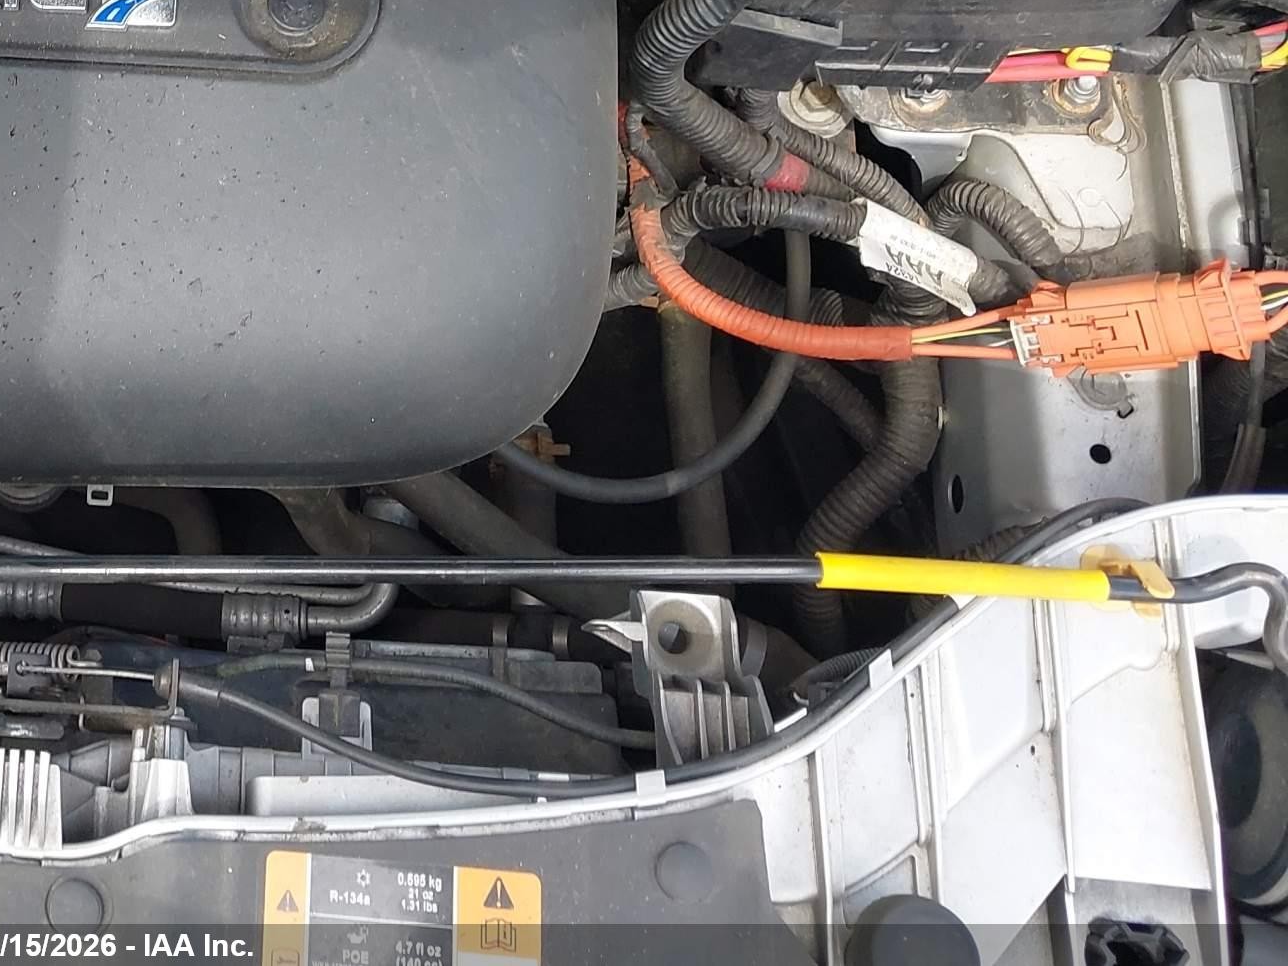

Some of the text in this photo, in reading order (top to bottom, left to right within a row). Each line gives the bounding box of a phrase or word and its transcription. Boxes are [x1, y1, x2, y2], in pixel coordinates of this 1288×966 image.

[429, 874, 442, 892] kg
[329, 889, 371, 906] R-134a
[408, 888, 434, 901] 21 oz
[423, 900, 438, 913] lbs
[396, 940, 442, 957] 4.7 fl oz
[342, 949, 369, 965] POE
